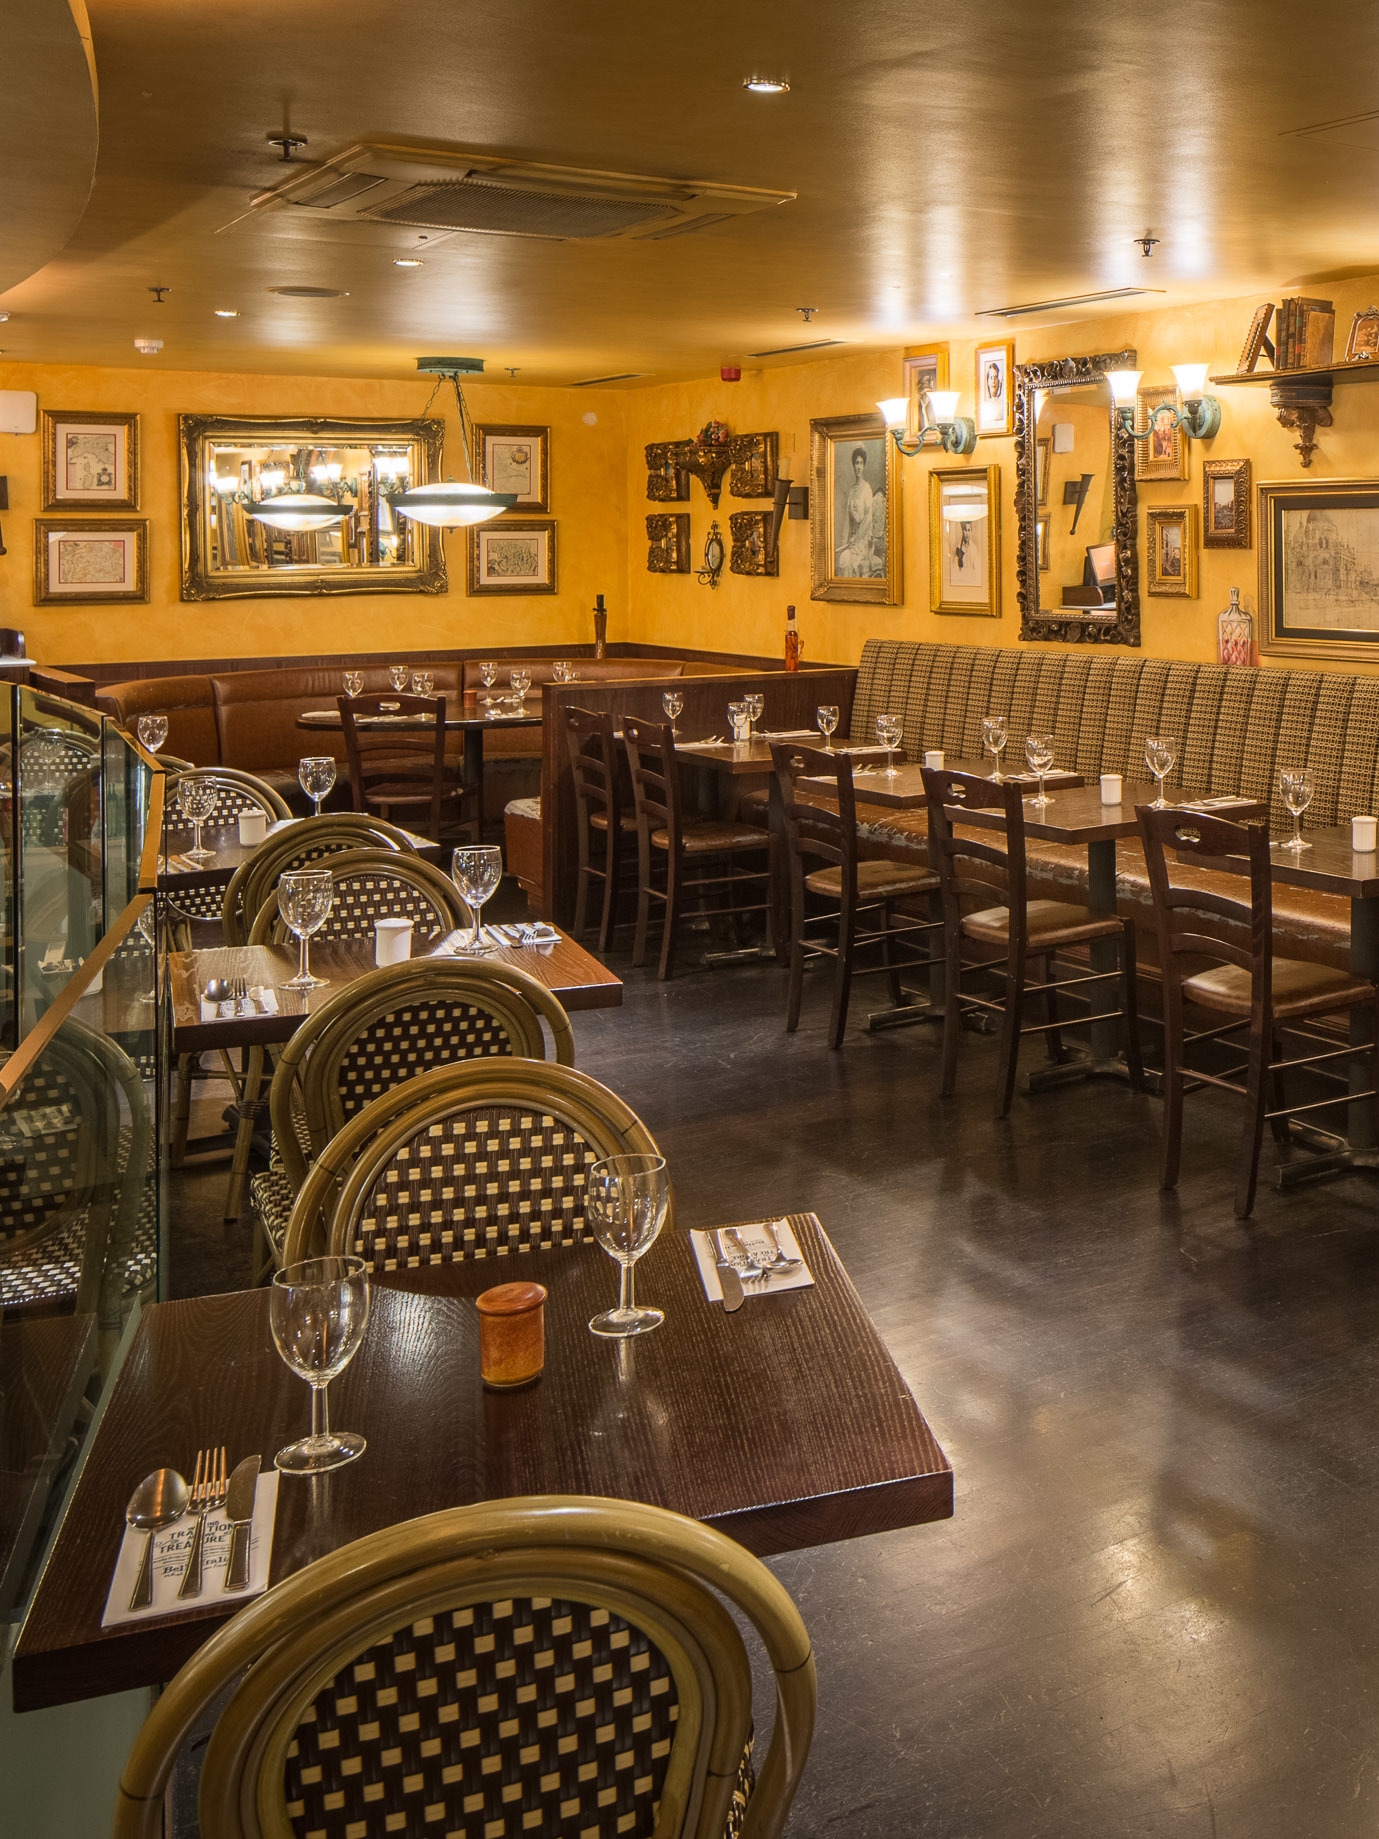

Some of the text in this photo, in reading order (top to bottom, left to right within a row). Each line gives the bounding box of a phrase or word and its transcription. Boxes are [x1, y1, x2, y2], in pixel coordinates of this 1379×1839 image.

[170, 1524, 234, 1540] TRATION
[160, 1535, 225, 1553] TREAURE
[162, 1563, 188, 1574] Bel
